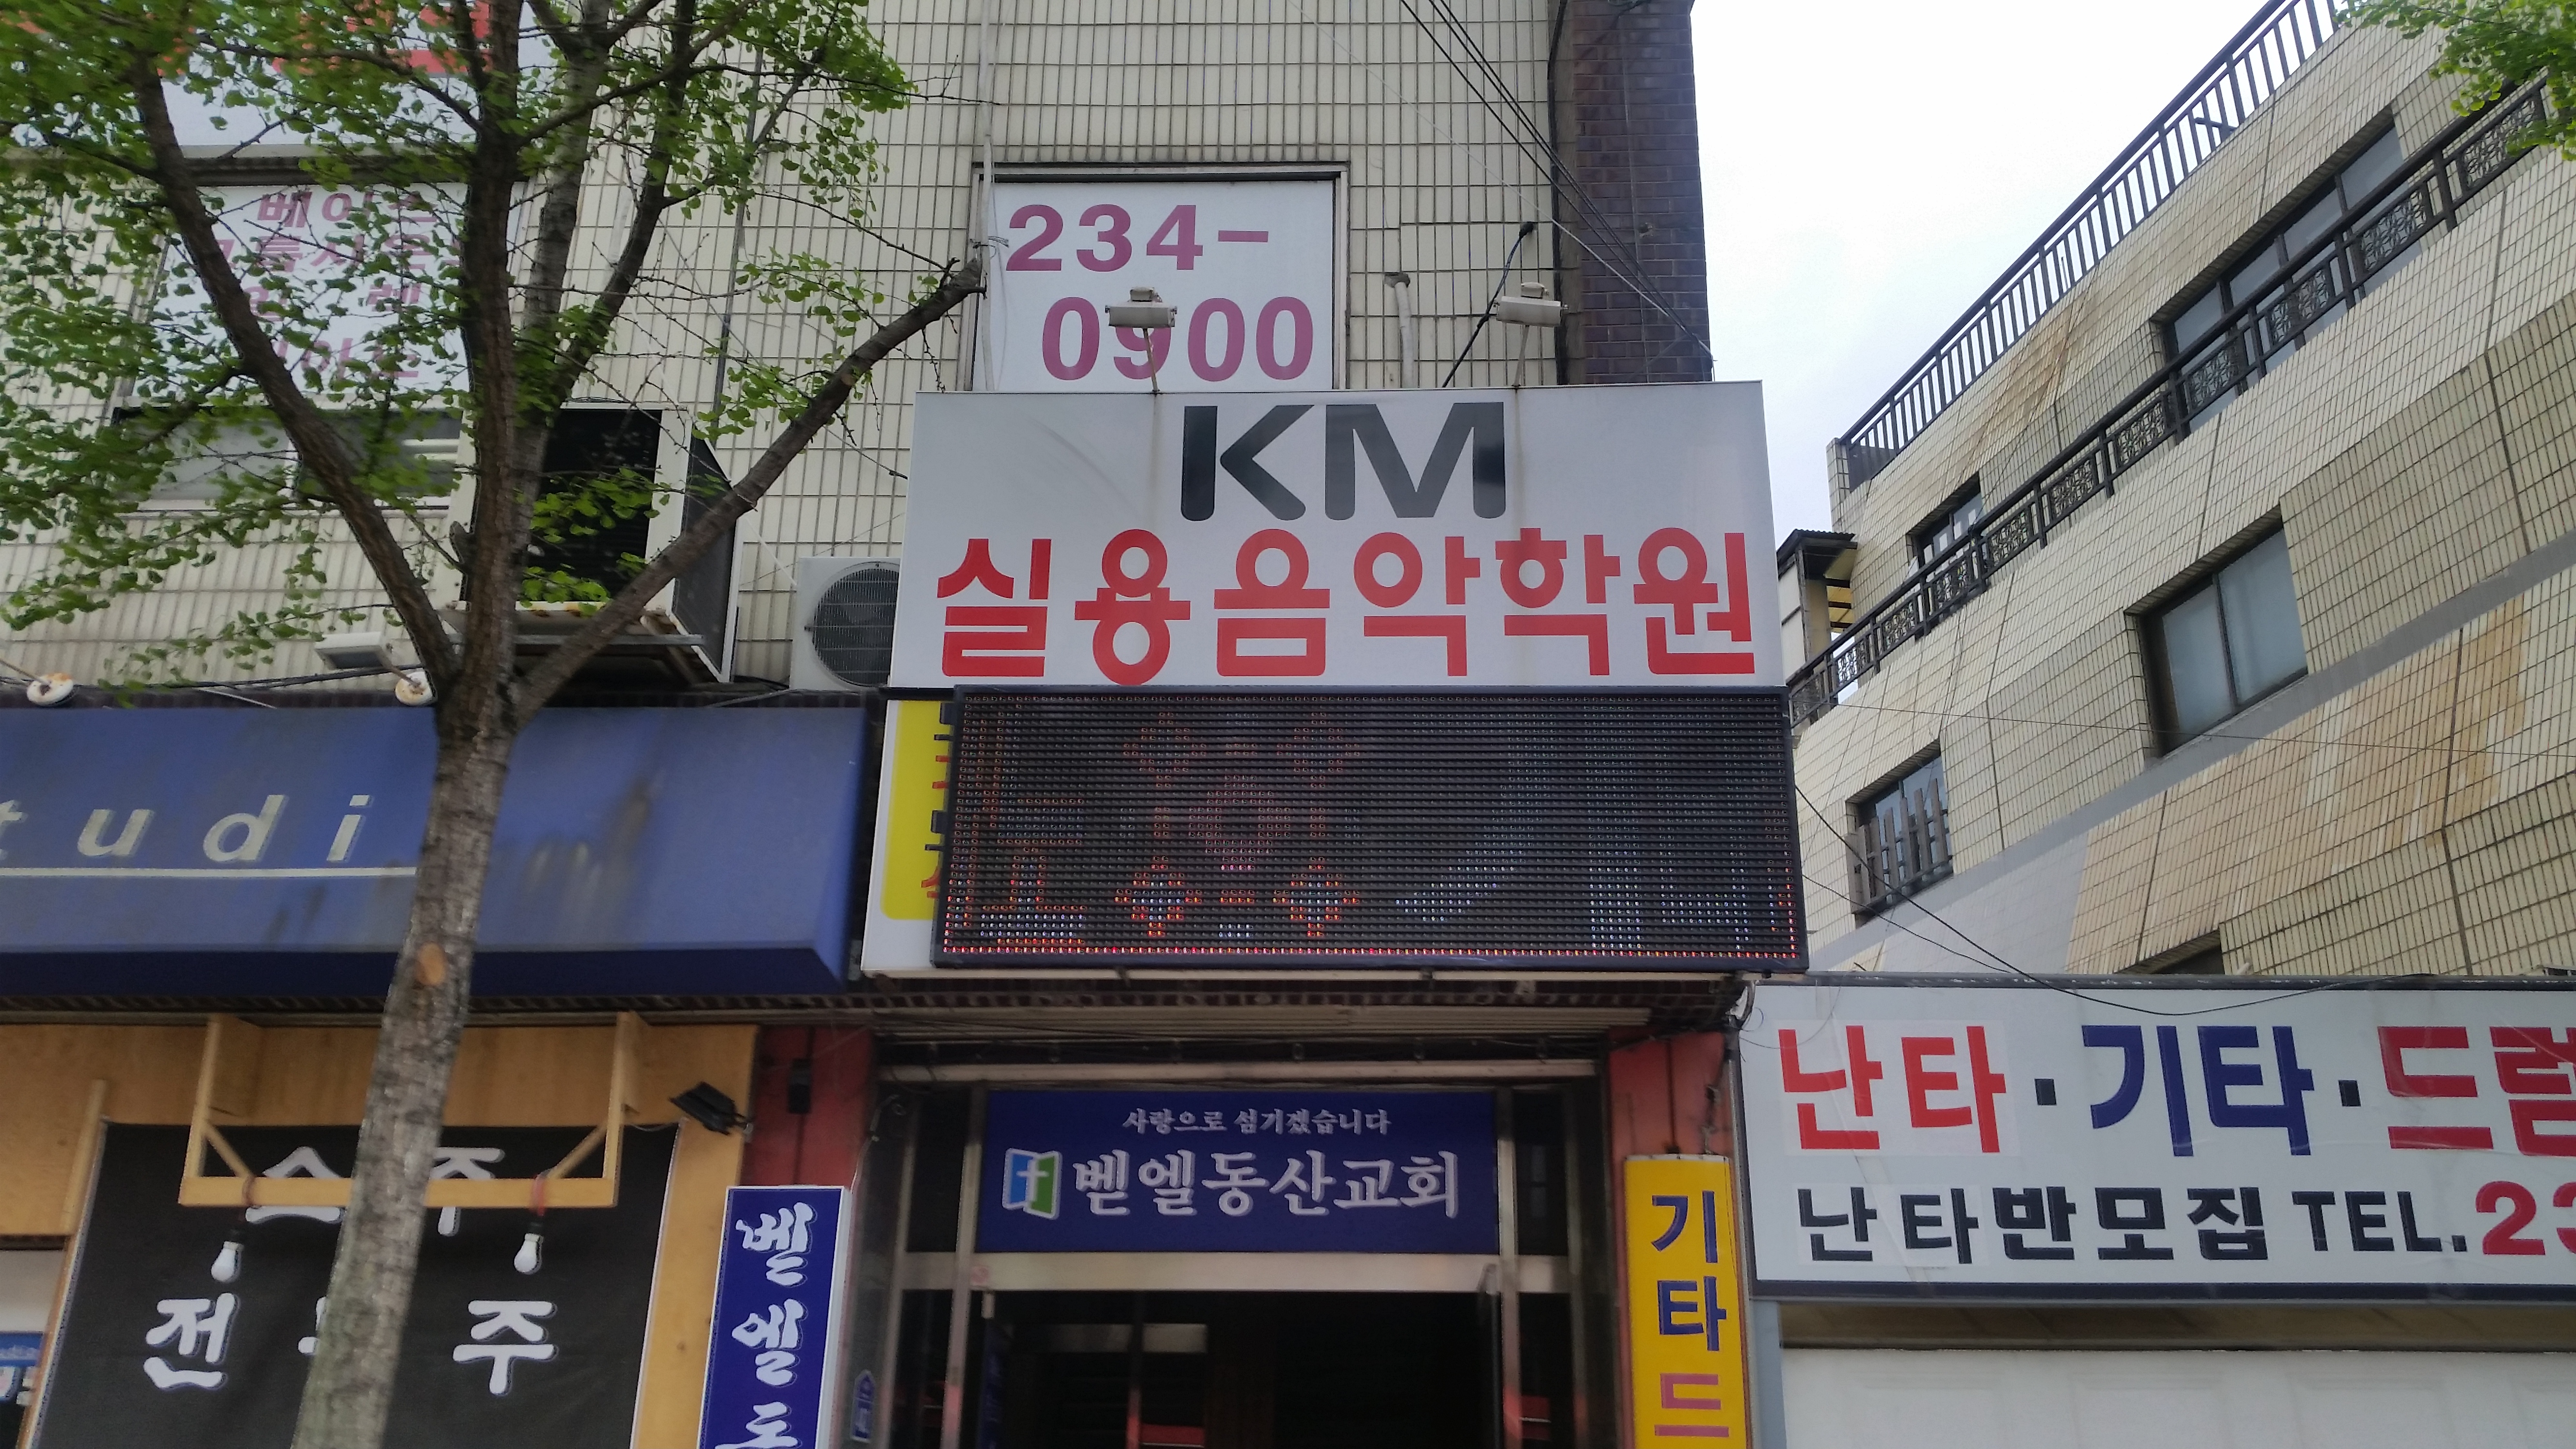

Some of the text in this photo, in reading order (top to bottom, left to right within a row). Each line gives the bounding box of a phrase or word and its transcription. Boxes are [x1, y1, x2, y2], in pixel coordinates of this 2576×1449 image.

[1005, 203, 1269, 272] 234-
[1042, 296, 1314, 383] 0900
[1180, 402, 1507, 522] KM
[936, 527, 1756, 686] 실용음악학원
[1122, 1108, 1392, 1135] 사랑으로 섬기겠습니다
[1074, 1149, 1459, 1219] 벧엘동산교회
